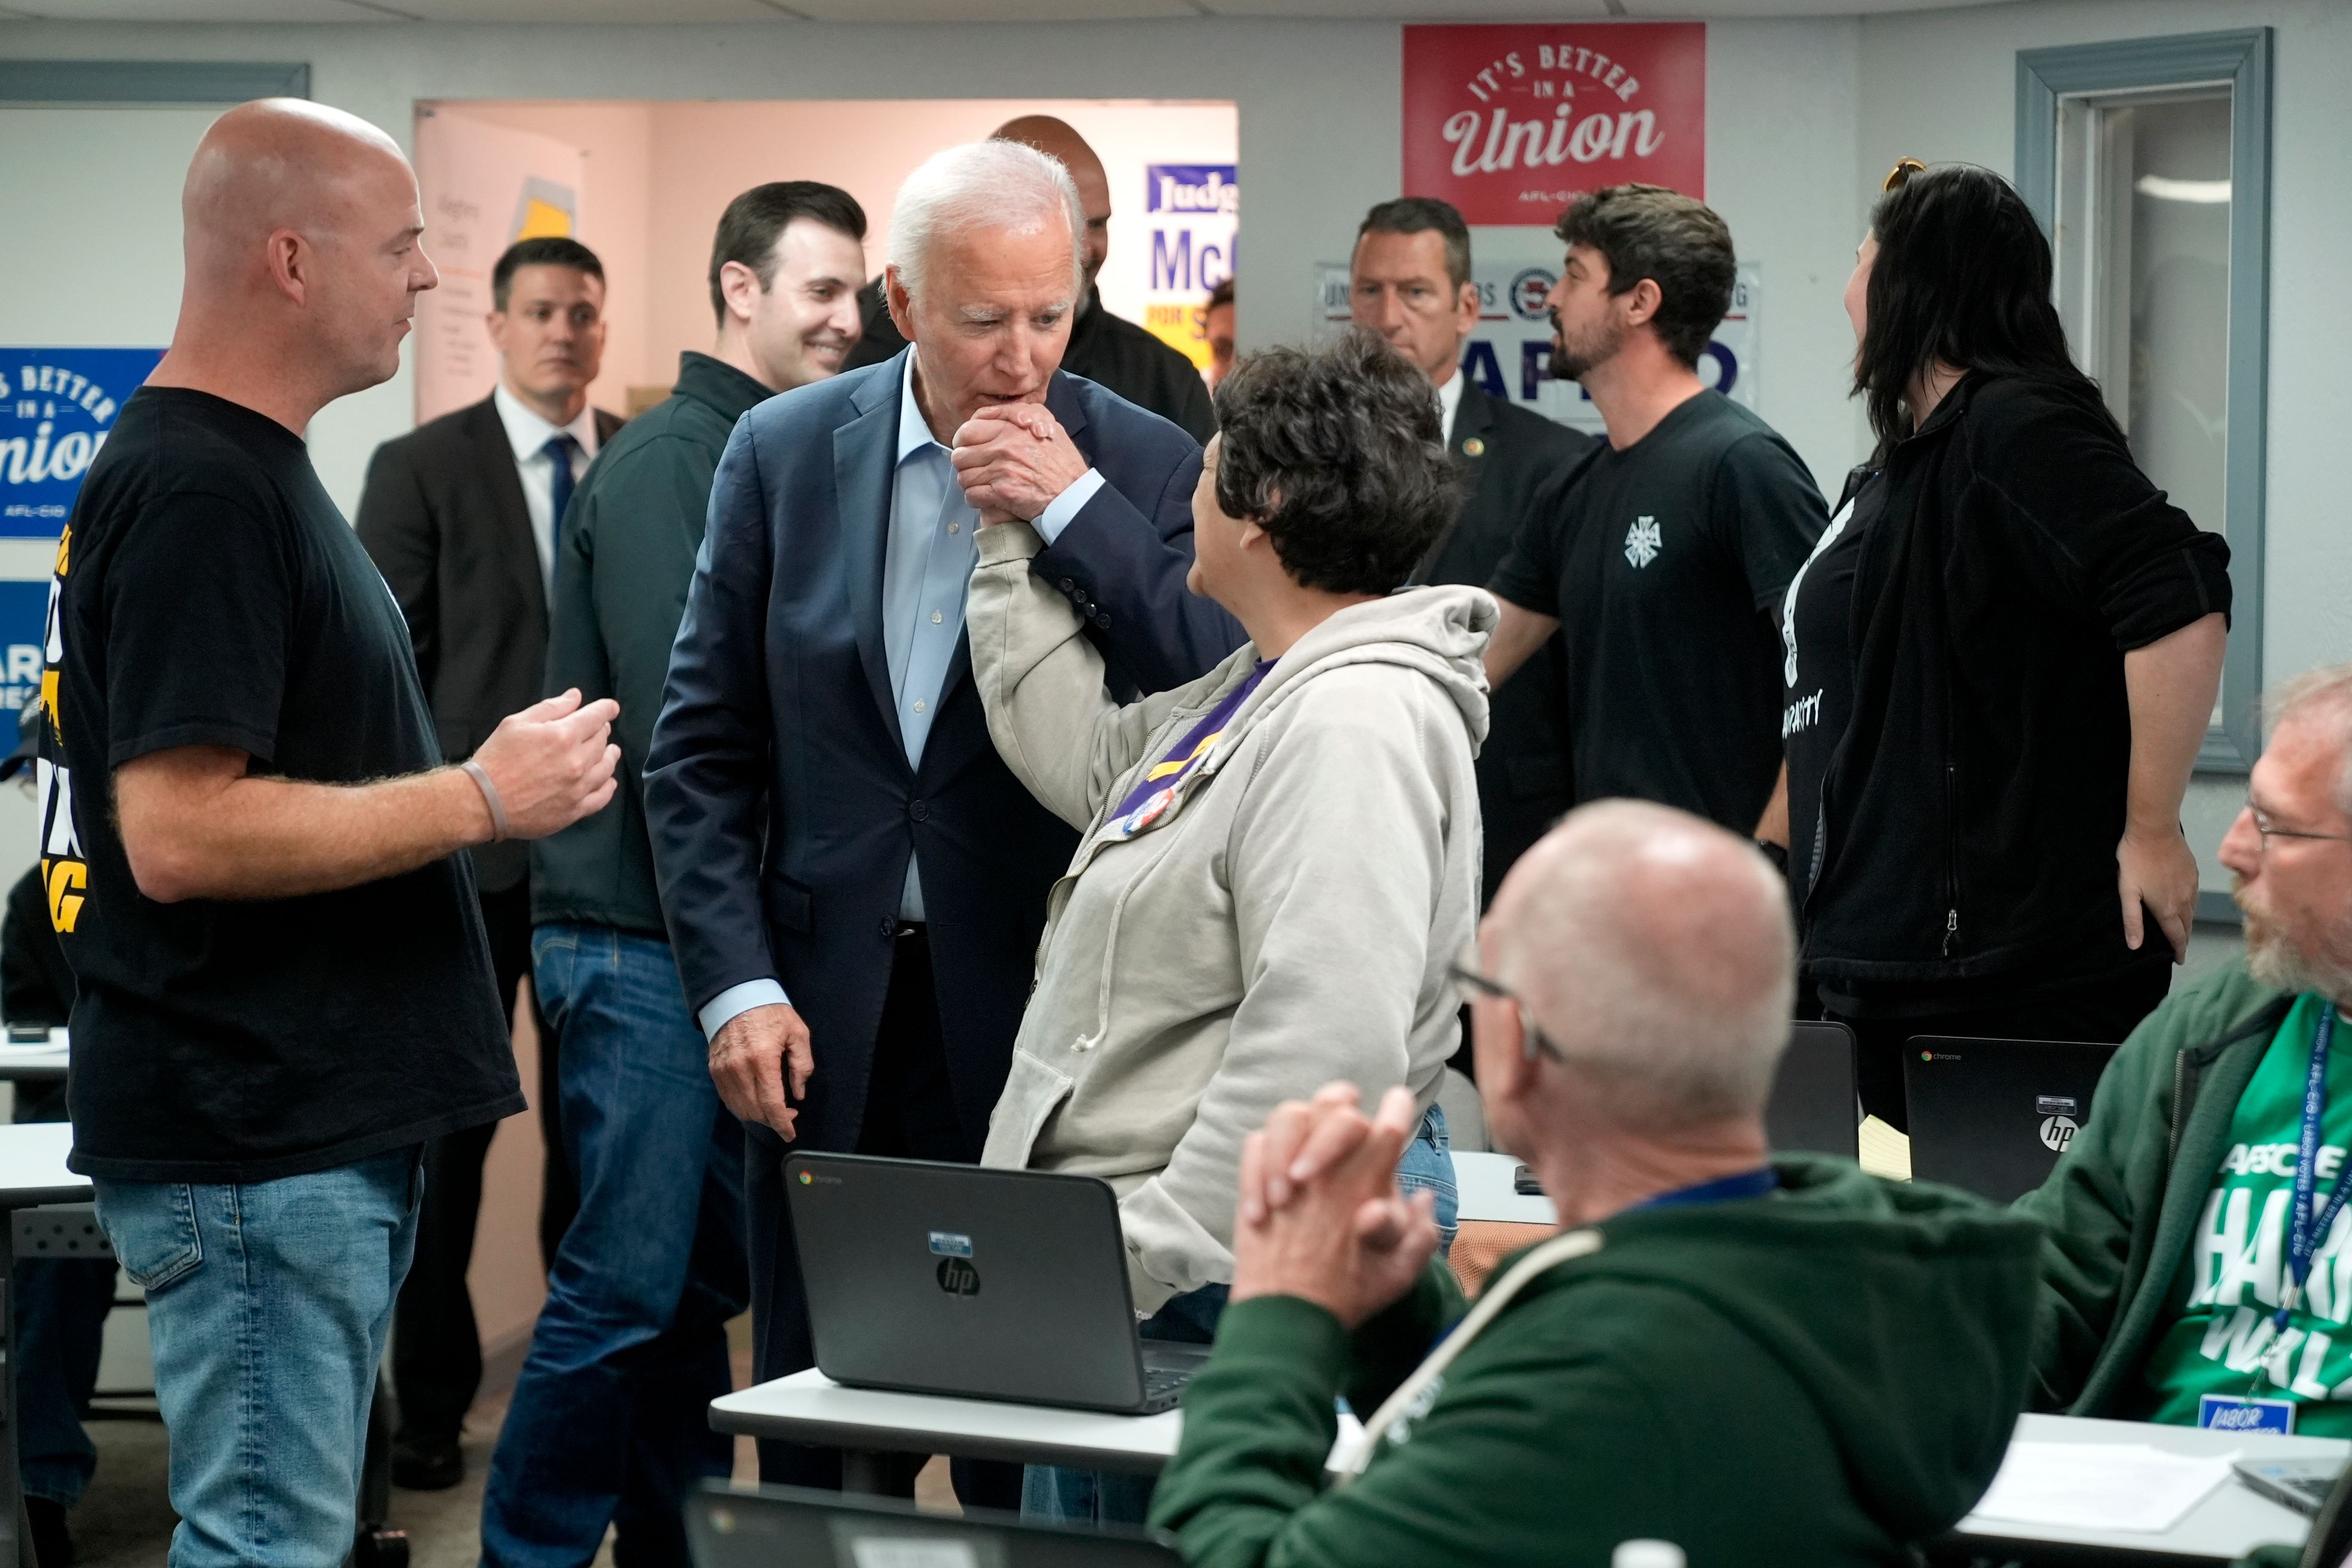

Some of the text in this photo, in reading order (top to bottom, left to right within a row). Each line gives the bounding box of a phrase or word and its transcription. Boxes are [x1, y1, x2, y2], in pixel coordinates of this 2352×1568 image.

[1467, 45, 1640, 102] IT'S BETTER
[1533, 80, 1575, 98] IN A
[1442, 102, 1665, 176] Union
[1153, 172, 1238, 213] Judg
[1152, 230, 1238, 290] Mc
[16, 399, 55, 419] IN A
[21, 365, 116, 424] BETTER
[0, 420, 110, 484] nio
[2306, 1063, 2323, 1115] AFL-CIO
[2046, 1116, 2075, 1152] hp
[2301, 1123, 2315, 1157] LABOR
[2218, 1142, 2348, 1180] AFSCE
[2297, 1158, 2311, 1192] VOTES
[2293, 1200, 2309, 1256] AFL-CIO
[2312, 1203, 2335, 1241] BETTER
[2332, 1192, 2345, 1208] IN
[944, 1256, 974, 1294] hp
[2208, 1406, 2264, 1430] LABOR
